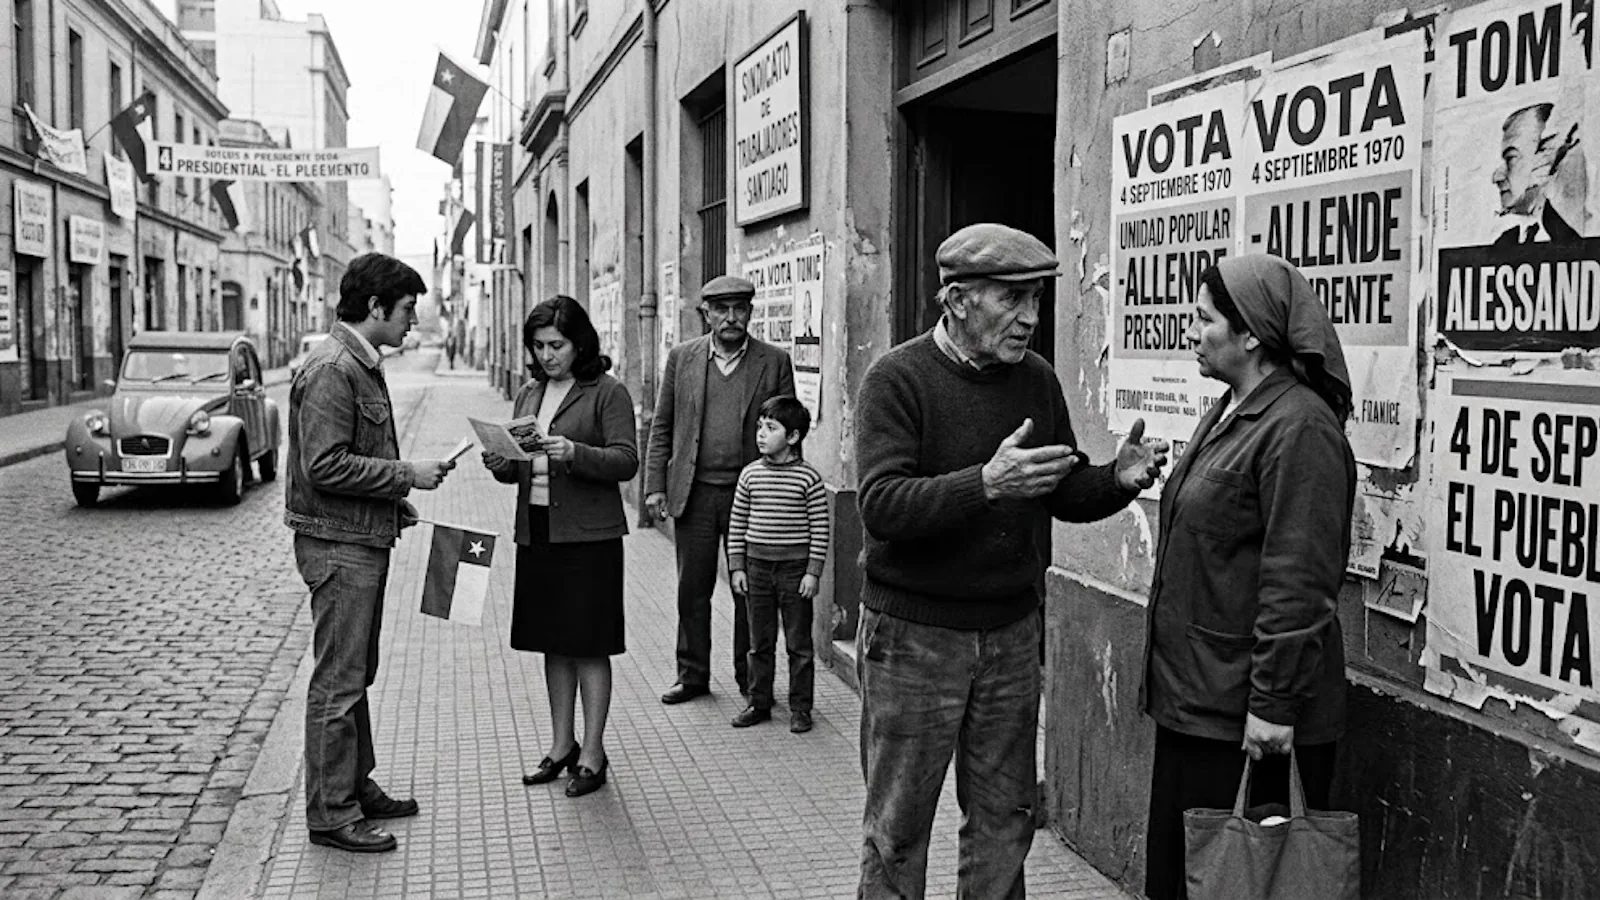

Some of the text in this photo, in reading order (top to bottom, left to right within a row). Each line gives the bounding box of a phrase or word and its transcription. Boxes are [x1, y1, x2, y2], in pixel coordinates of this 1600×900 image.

[742, 40, 791, 102] SINDICATO
[761, 97, 771, 118] DE
[1252, 64, 1406, 153] VOTA
[177, 159, 266, 177] PRESIDENTIAL
[738, 111, 798, 169] TRABAJADORES
[1121, 109, 1232, 179] VOTA
[1252, 135, 1404, 184] 4 SEPTIEMBRE 1970
[1120, 167, 1231, 205] 4 SEPTIEMBRE 1970
[1120, 208, 1230, 249] UNIDAD POPULAR
[1309, 274, 1393, 324] DENTE
[1445, 260, 1600, 332] ALESSAND
[1450, 406, 1600, 487] 4 DE SEP
[1447, 481, 1600, 583] EL PUEBL
[1473, 568, 1593, 688] VOTA
